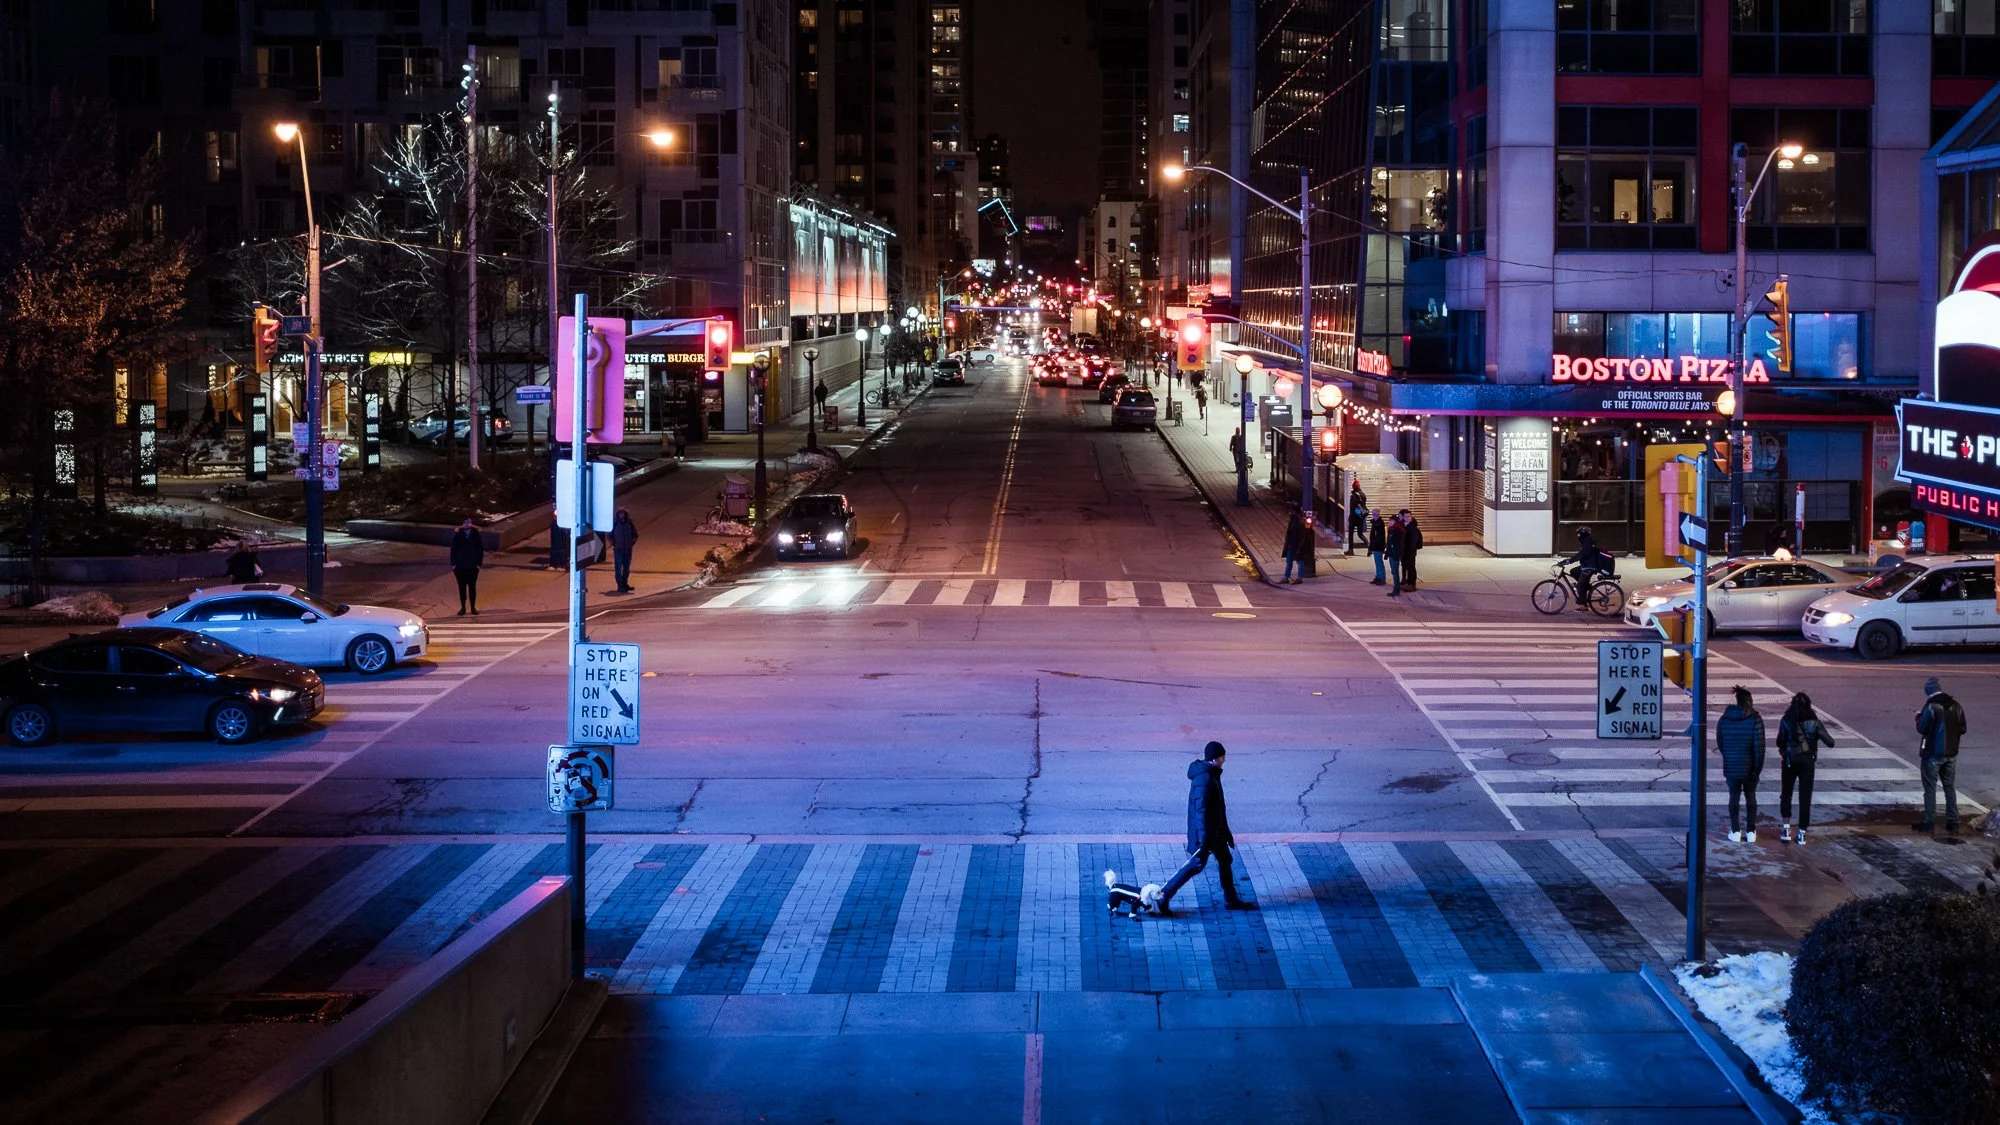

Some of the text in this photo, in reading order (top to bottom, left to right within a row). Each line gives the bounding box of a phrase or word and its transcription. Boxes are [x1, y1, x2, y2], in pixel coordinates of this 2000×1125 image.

[625, 353, 706, 363] UTH ST. BURGE
[1552, 354, 1674, 382] BOSTON
[1618, 391, 1702, 400] OFFICIAL SPORTS BAR
[1602, 400, 1612, 409] OF
[1614, 400, 1629, 409] THE
[1631, 401, 1668, 409] TORONTO
[1669, 401, 1691, 410] BLUE
[1690, 401, 1710, 410] JAYS
[1510, 438, 1548, 449] WELCOME
[1906, 424, 1958, 459] THE
[1501, 438, 1510, 463] John
[1521, 459, 1544, 469] A FAN
[1916, 485, 1980, 513] PUBLIC
[586, 649, 628, 662] STOP
[1610, 647, 1651, 660] STOP
[585, 668, 628, 682] HERE
[1609, 666, 1651, 678] HERE
[582, 686, 600, 700] ON
[1641, 684, 1658, 697] ON
[581, 705, 608, 719] RED
[1632, 702, 1657, 715] RED
[581, 724, 630, 738] SIGNAL
[1611, 721, 1657, 734] SIGNAL
